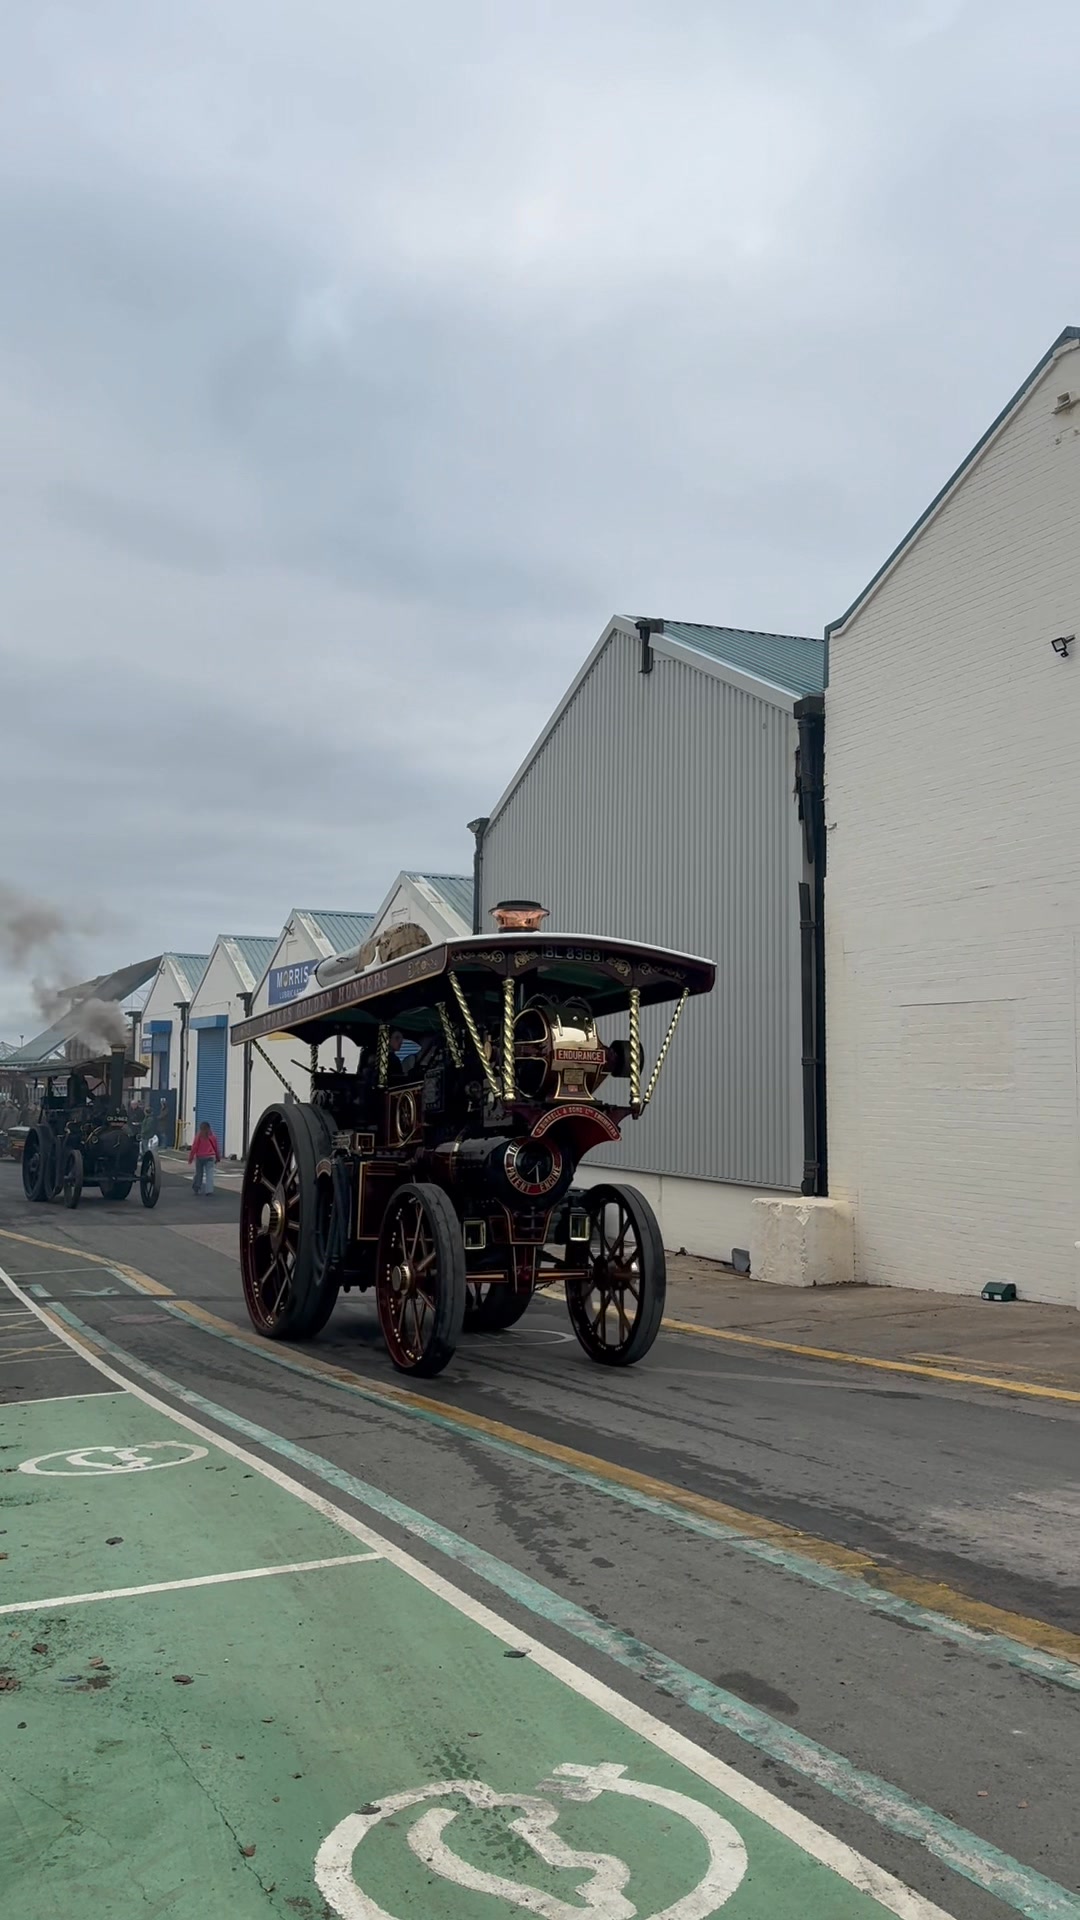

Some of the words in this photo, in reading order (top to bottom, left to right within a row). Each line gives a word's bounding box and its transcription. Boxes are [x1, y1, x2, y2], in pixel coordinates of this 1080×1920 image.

[546, 945, 563, 958] BL
[567, 947, 600, 961] 8368
[276, 966, 309, 988] MORRIS
[296, 990, 333, 1018] GOLDEN
[338, 970, 388, 1002] HUNTERS
[558, 1050, 602, 1061] ENDURANCE
[507, 1166, 530, 1193] PATENT
[540, 1166, 561, 1192] ENGINE
